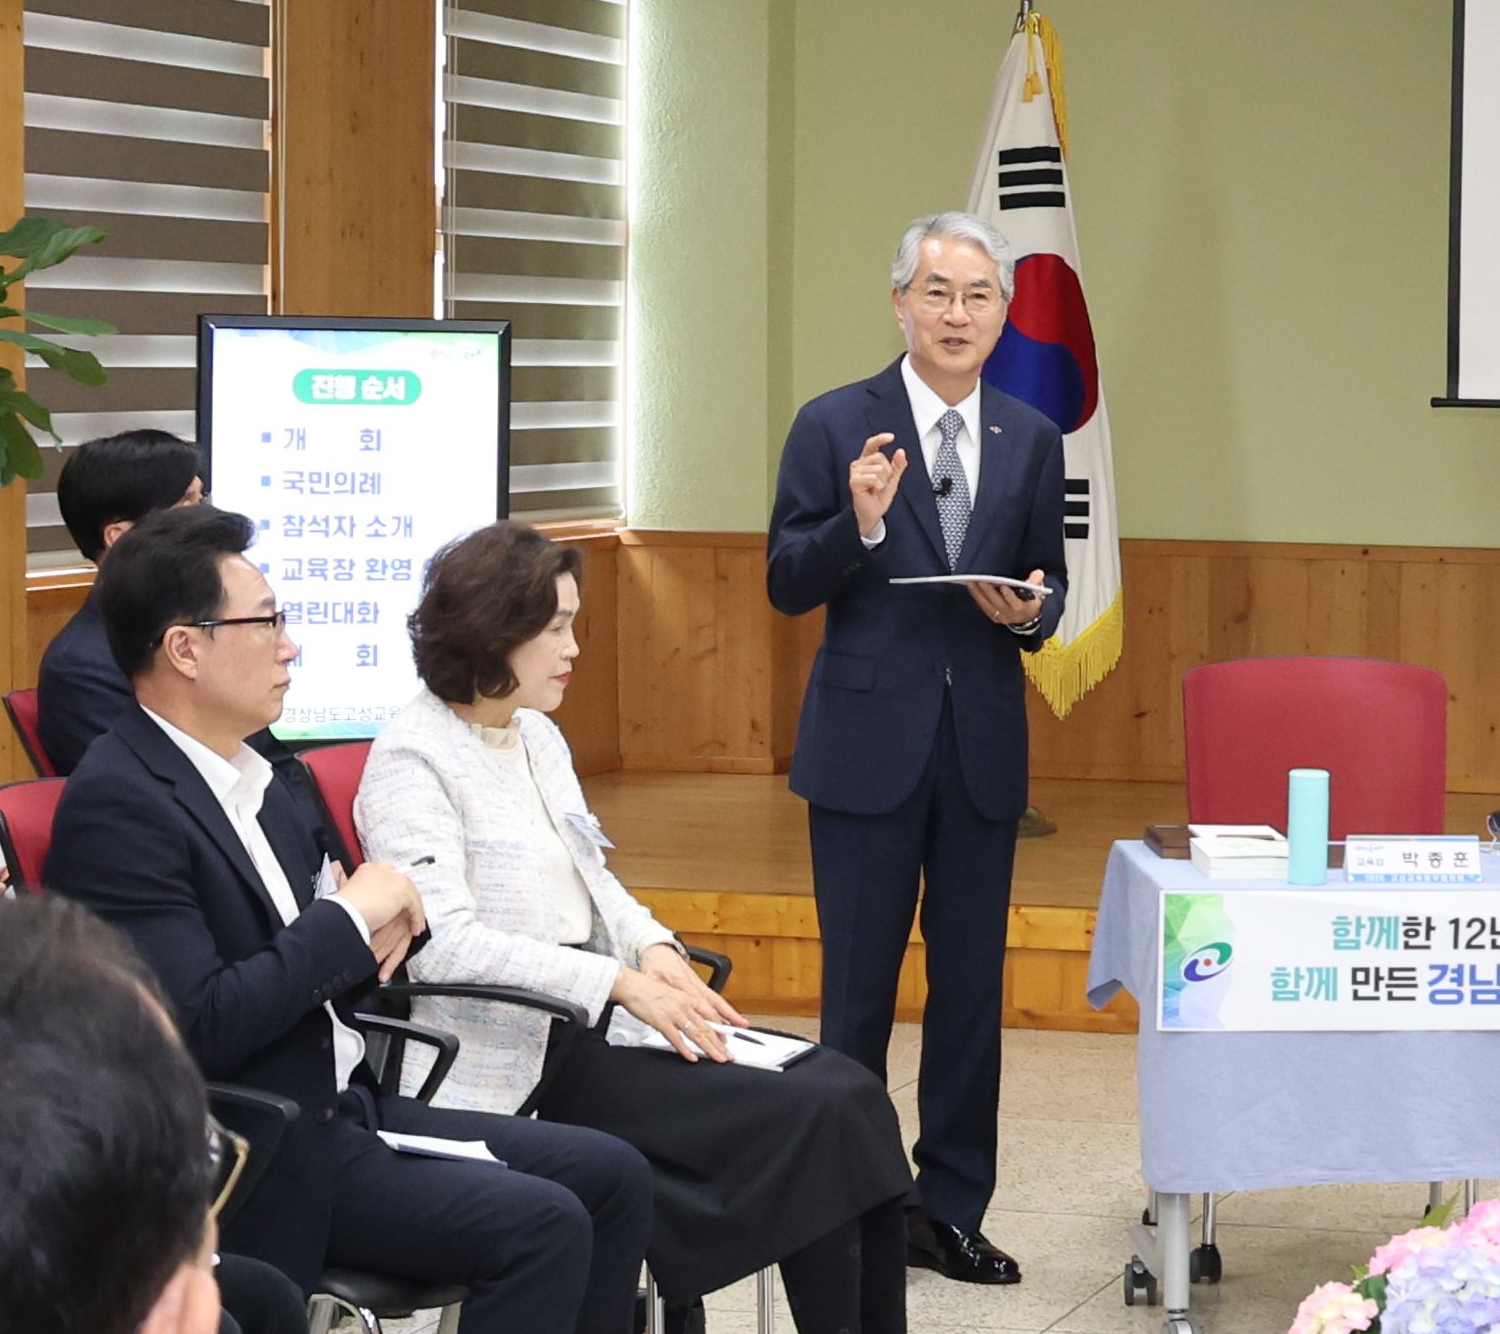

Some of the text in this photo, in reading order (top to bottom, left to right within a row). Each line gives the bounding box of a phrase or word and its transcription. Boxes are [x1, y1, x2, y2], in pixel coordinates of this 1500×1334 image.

[311, 374, 406, 401] 진행 순서
[283, 471, 381, 495] 국민의례
[282, 514, 413, 538] 참석자 소개
[281, 558, 355, 581] 교육장
[281, 601, 380, 624] 열린대화
[1331, 916, 1436, 950] 함께한
[1271, 966, 1338, 1001] 함께
[1351, 966, 1419, 1001] 만든
